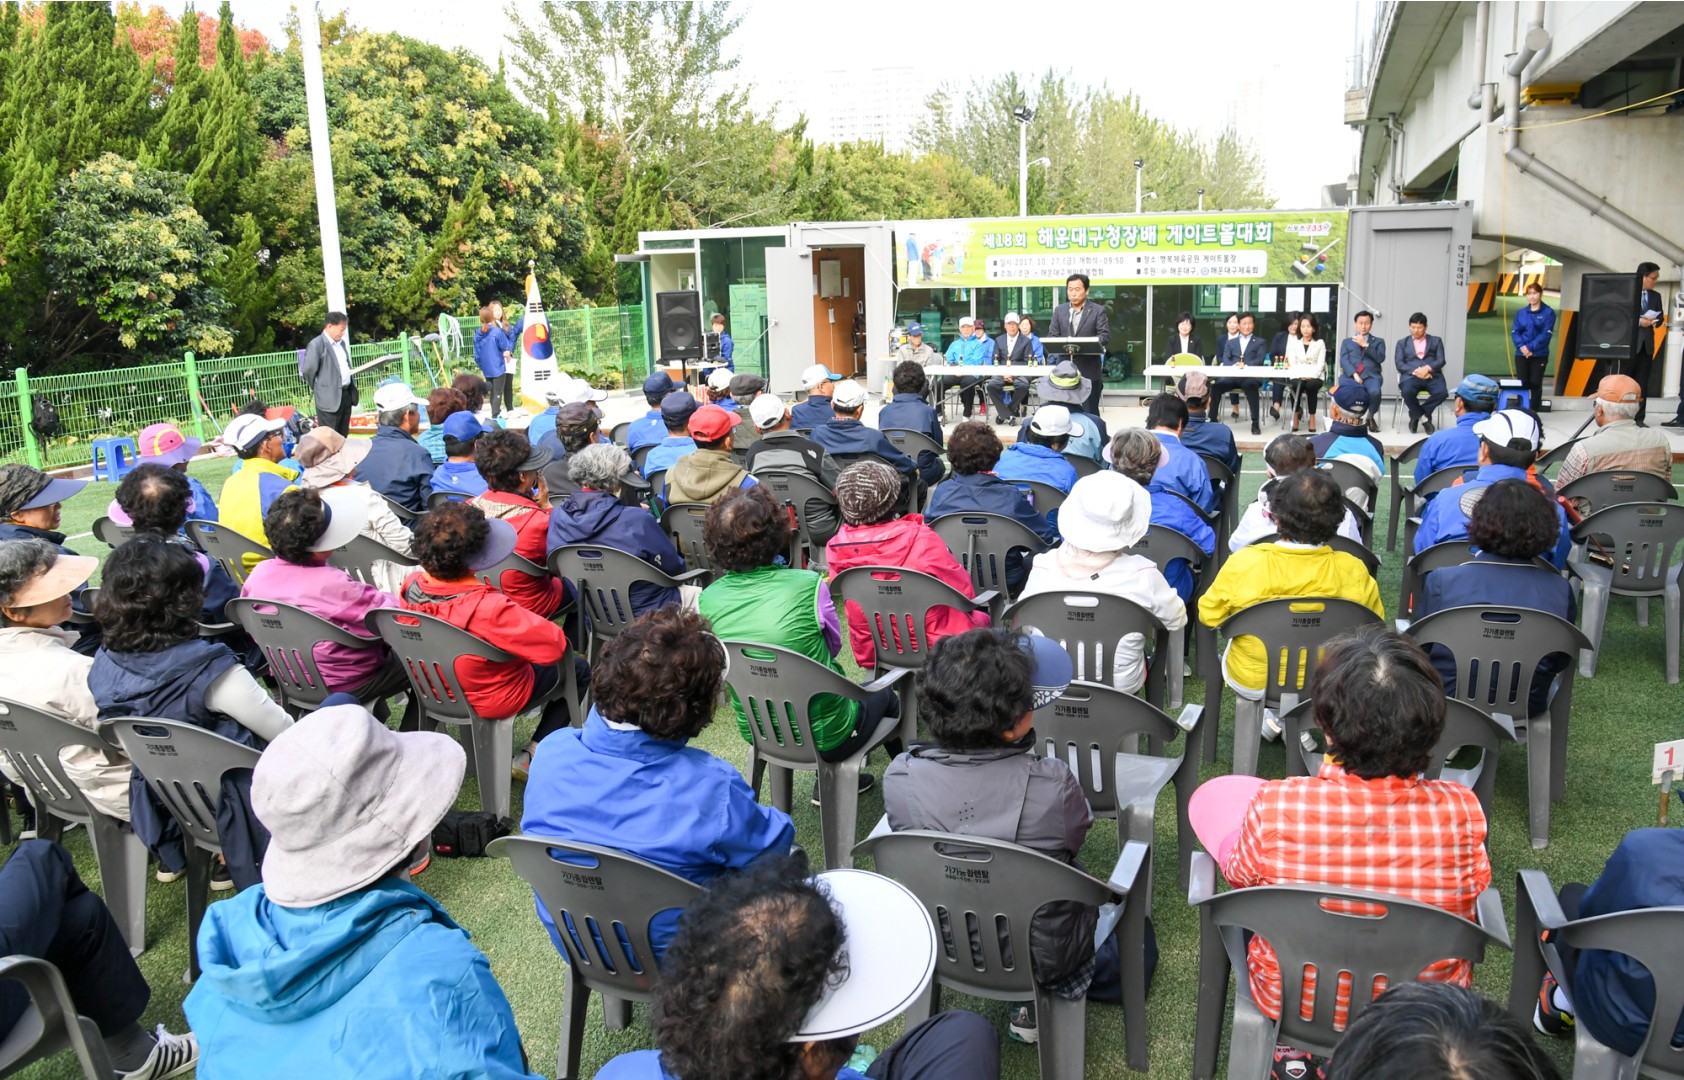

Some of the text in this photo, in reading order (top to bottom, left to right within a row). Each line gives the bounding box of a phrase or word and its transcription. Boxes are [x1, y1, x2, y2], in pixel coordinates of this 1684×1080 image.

[983, 221, 1273, 249] 제18회 해운대구청장배 게이트볼대회
[1203, 254, 1237, 263] 게이트볼장
[1664, 747, 1674, 766] 1
